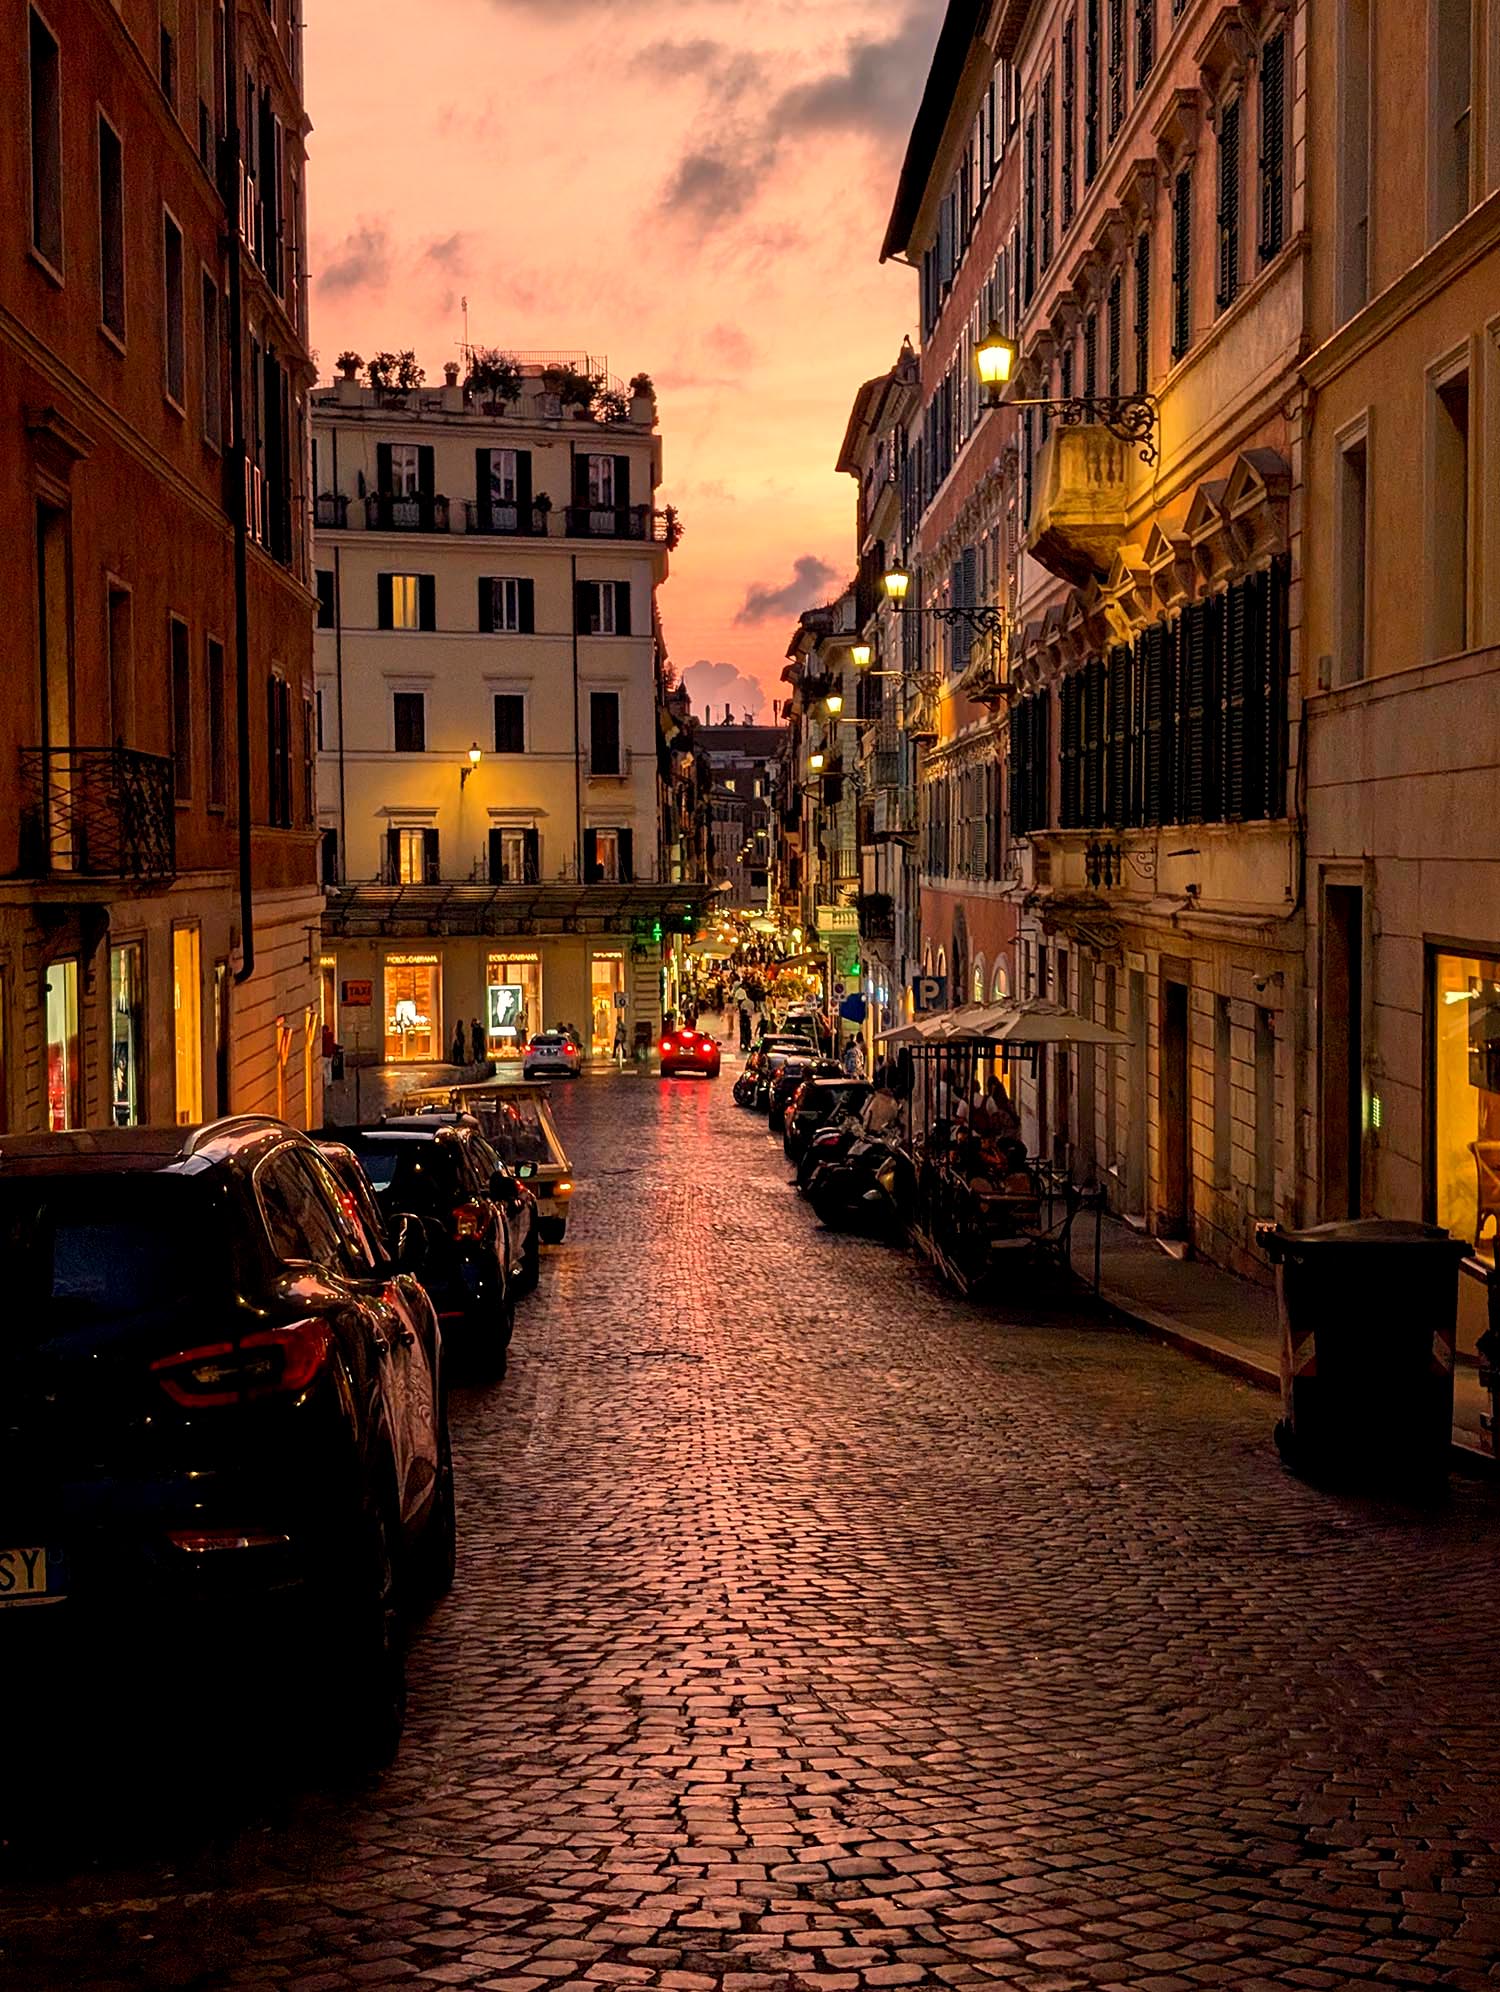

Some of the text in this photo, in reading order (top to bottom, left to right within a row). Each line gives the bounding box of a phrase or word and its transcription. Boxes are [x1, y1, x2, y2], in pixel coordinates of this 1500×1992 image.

[349, 986, 371, 996] TAXI
[919, 979, 940, 1010] P
[0, 1550, 40, 1591] SY
